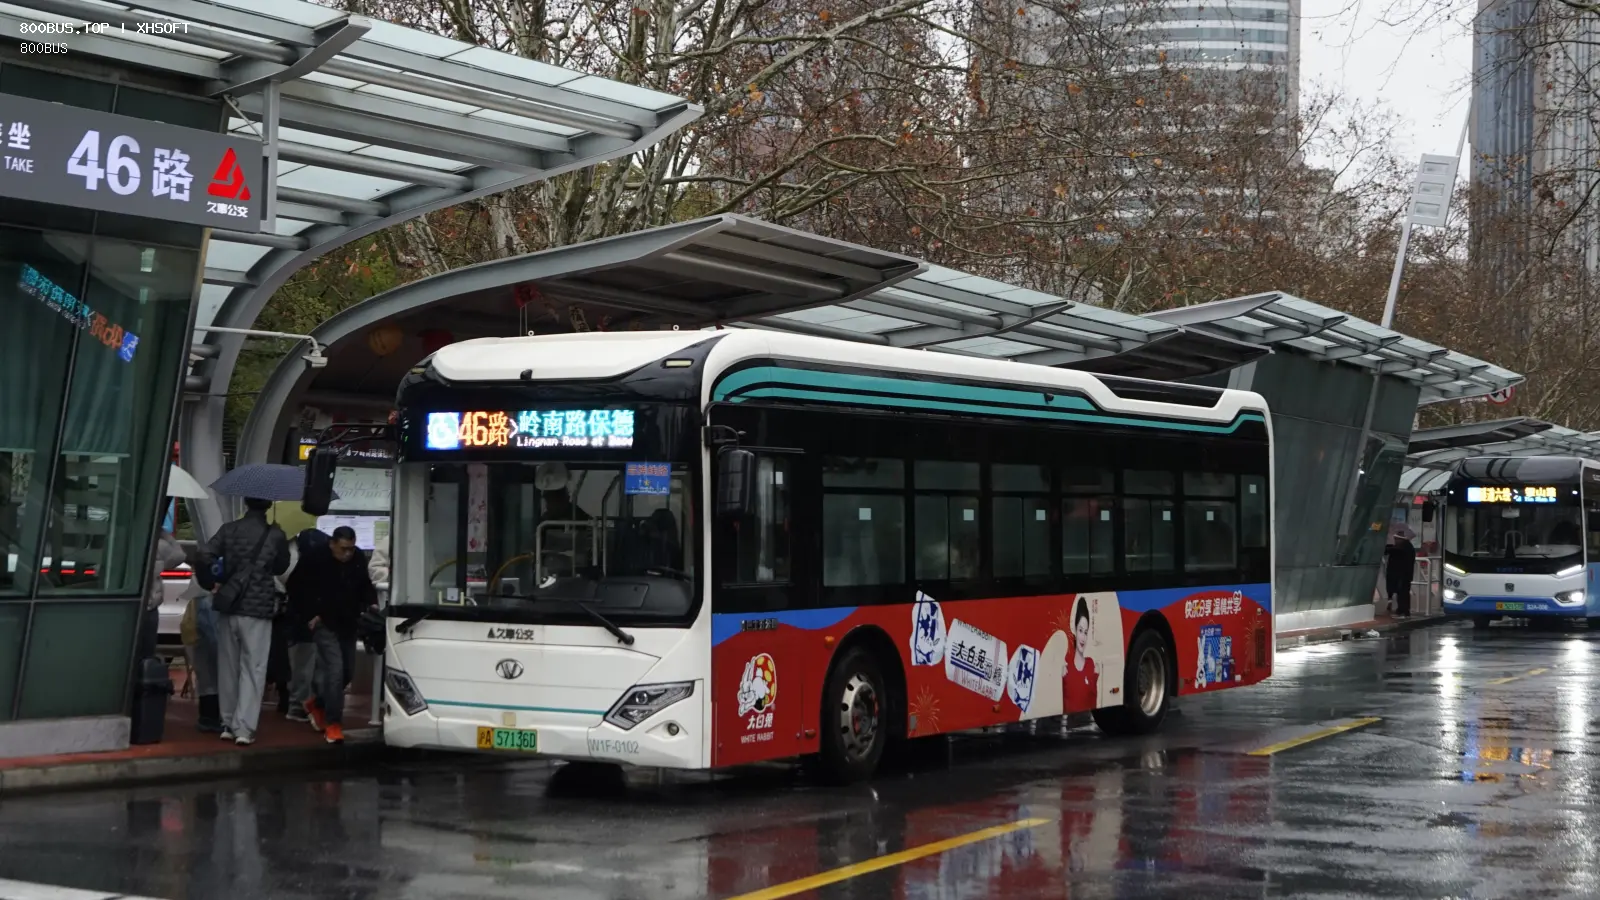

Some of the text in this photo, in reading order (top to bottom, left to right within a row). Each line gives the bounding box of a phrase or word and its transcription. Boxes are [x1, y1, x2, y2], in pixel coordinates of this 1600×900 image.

[0, 121, 31, 150] 坐
[4, 155, 34, 174] TAKE
[206, 200, 249, 218] 久事公交
[459, 409, 635, 447] 46路 岭南路保德
[516, 436, 559, 448] Lingnan
[562, 436, 588, 446] Road
[746, 712, 774, 730] 大白兔
[588, 739, 640, 754] W1F-0102
[740, 731, 774, 744] WHITE RABBIT
